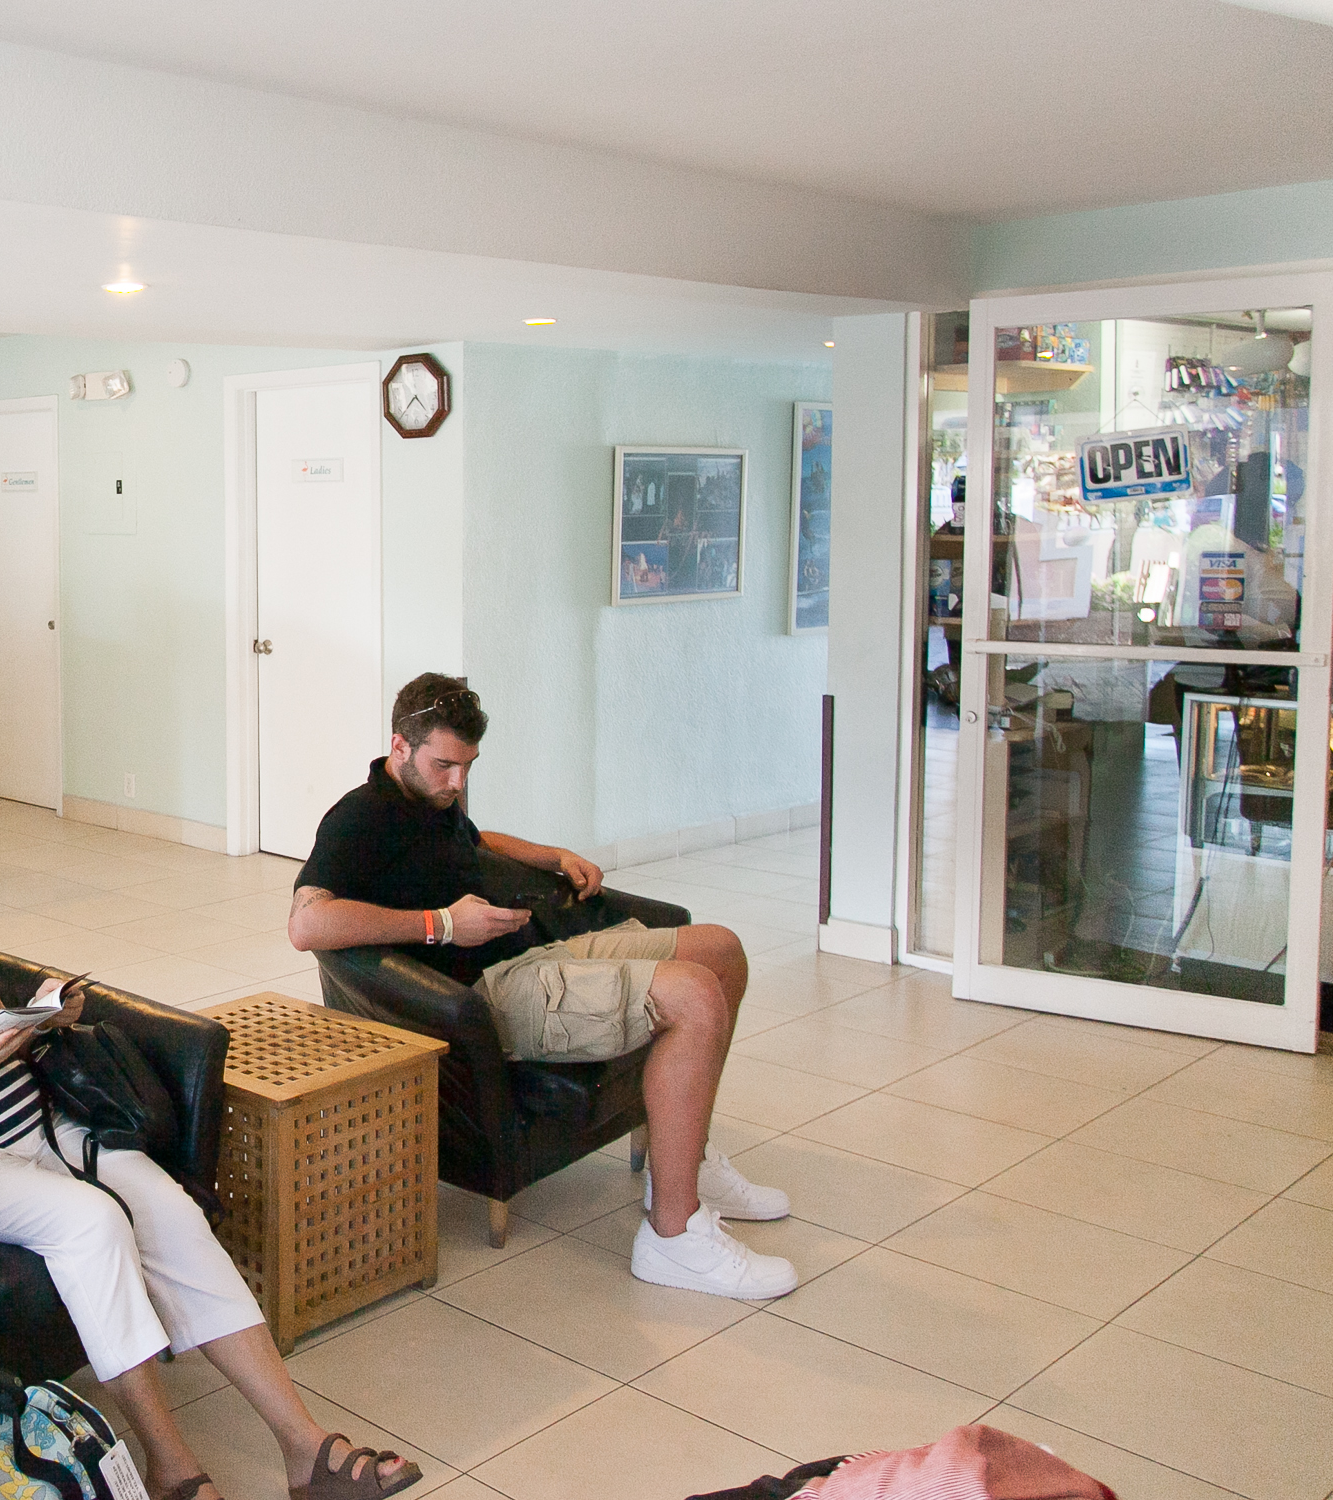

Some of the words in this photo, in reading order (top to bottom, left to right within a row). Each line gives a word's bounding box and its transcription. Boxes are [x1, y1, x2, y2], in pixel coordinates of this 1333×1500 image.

[1087, 436, 1182, 485] OPEN
[310, 466, 332, 475] Ladies
[1209, 559, 1237, 568] VISA
